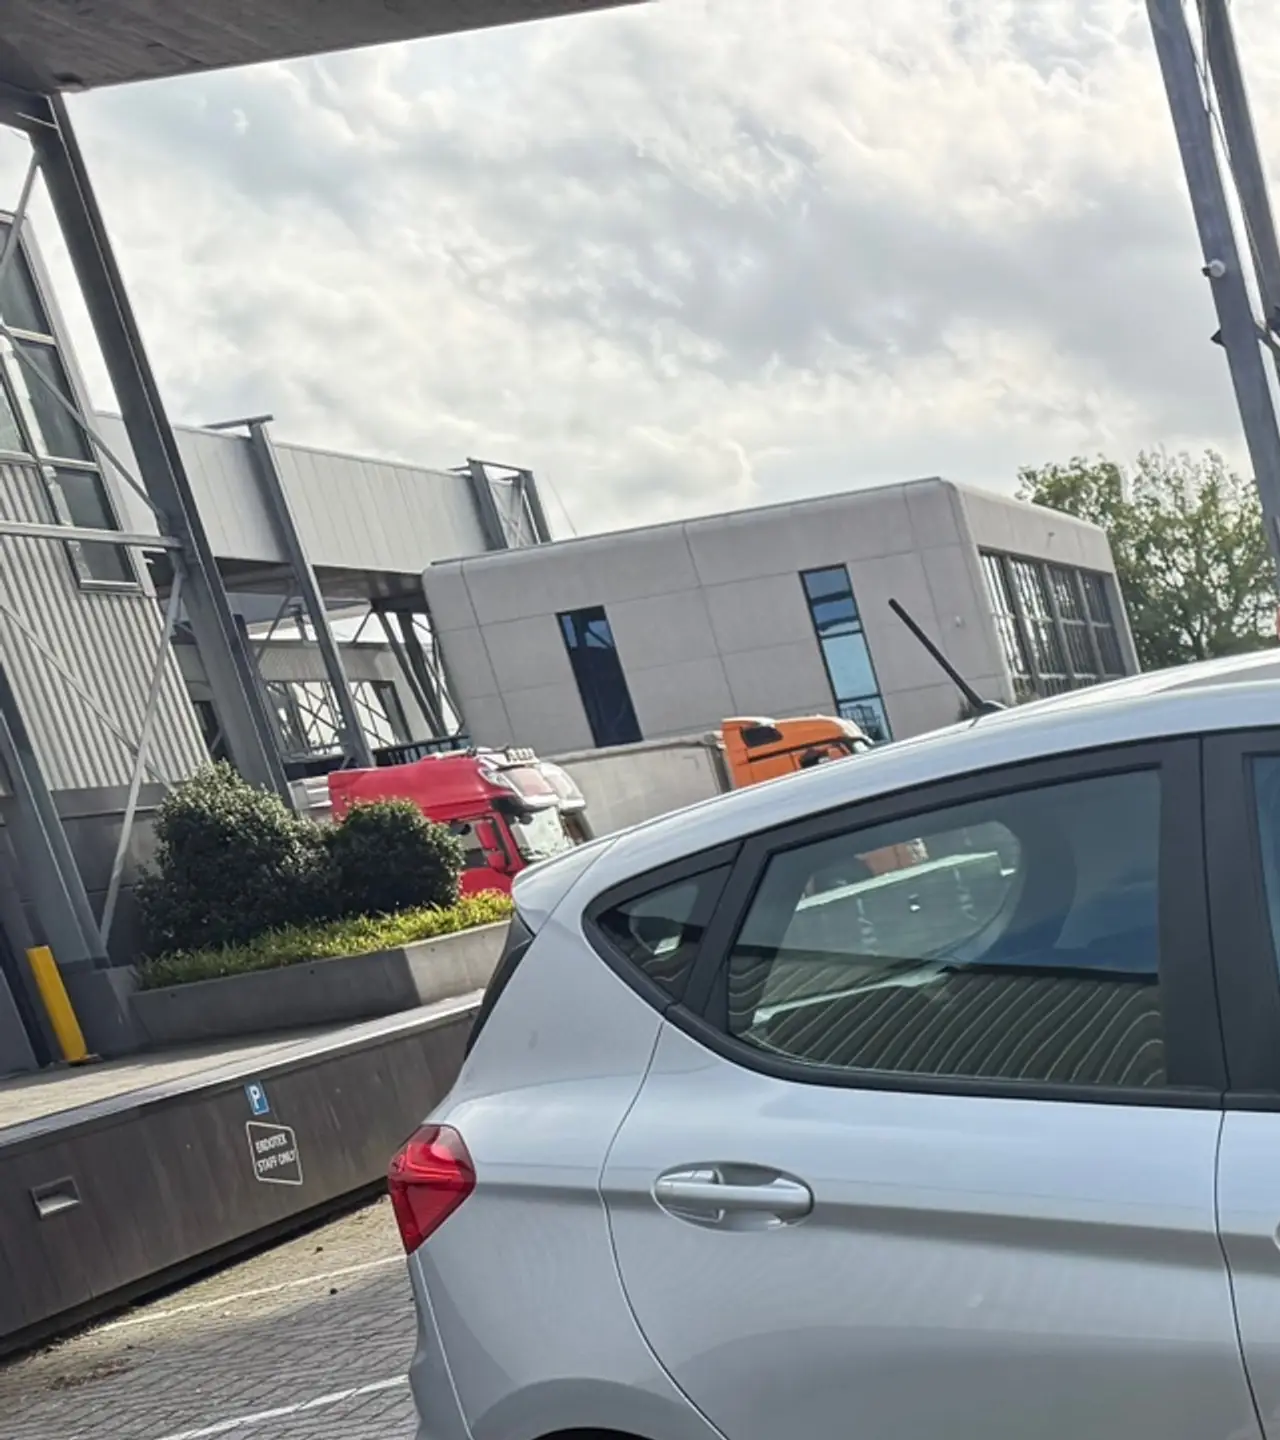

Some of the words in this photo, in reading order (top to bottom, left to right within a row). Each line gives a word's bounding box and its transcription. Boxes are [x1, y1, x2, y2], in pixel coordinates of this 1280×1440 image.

[249, 1085, 261, 1109] P
[257, 1155, 277, 1172] STAFF
[278, 1149, 296, 1165] ONLY
